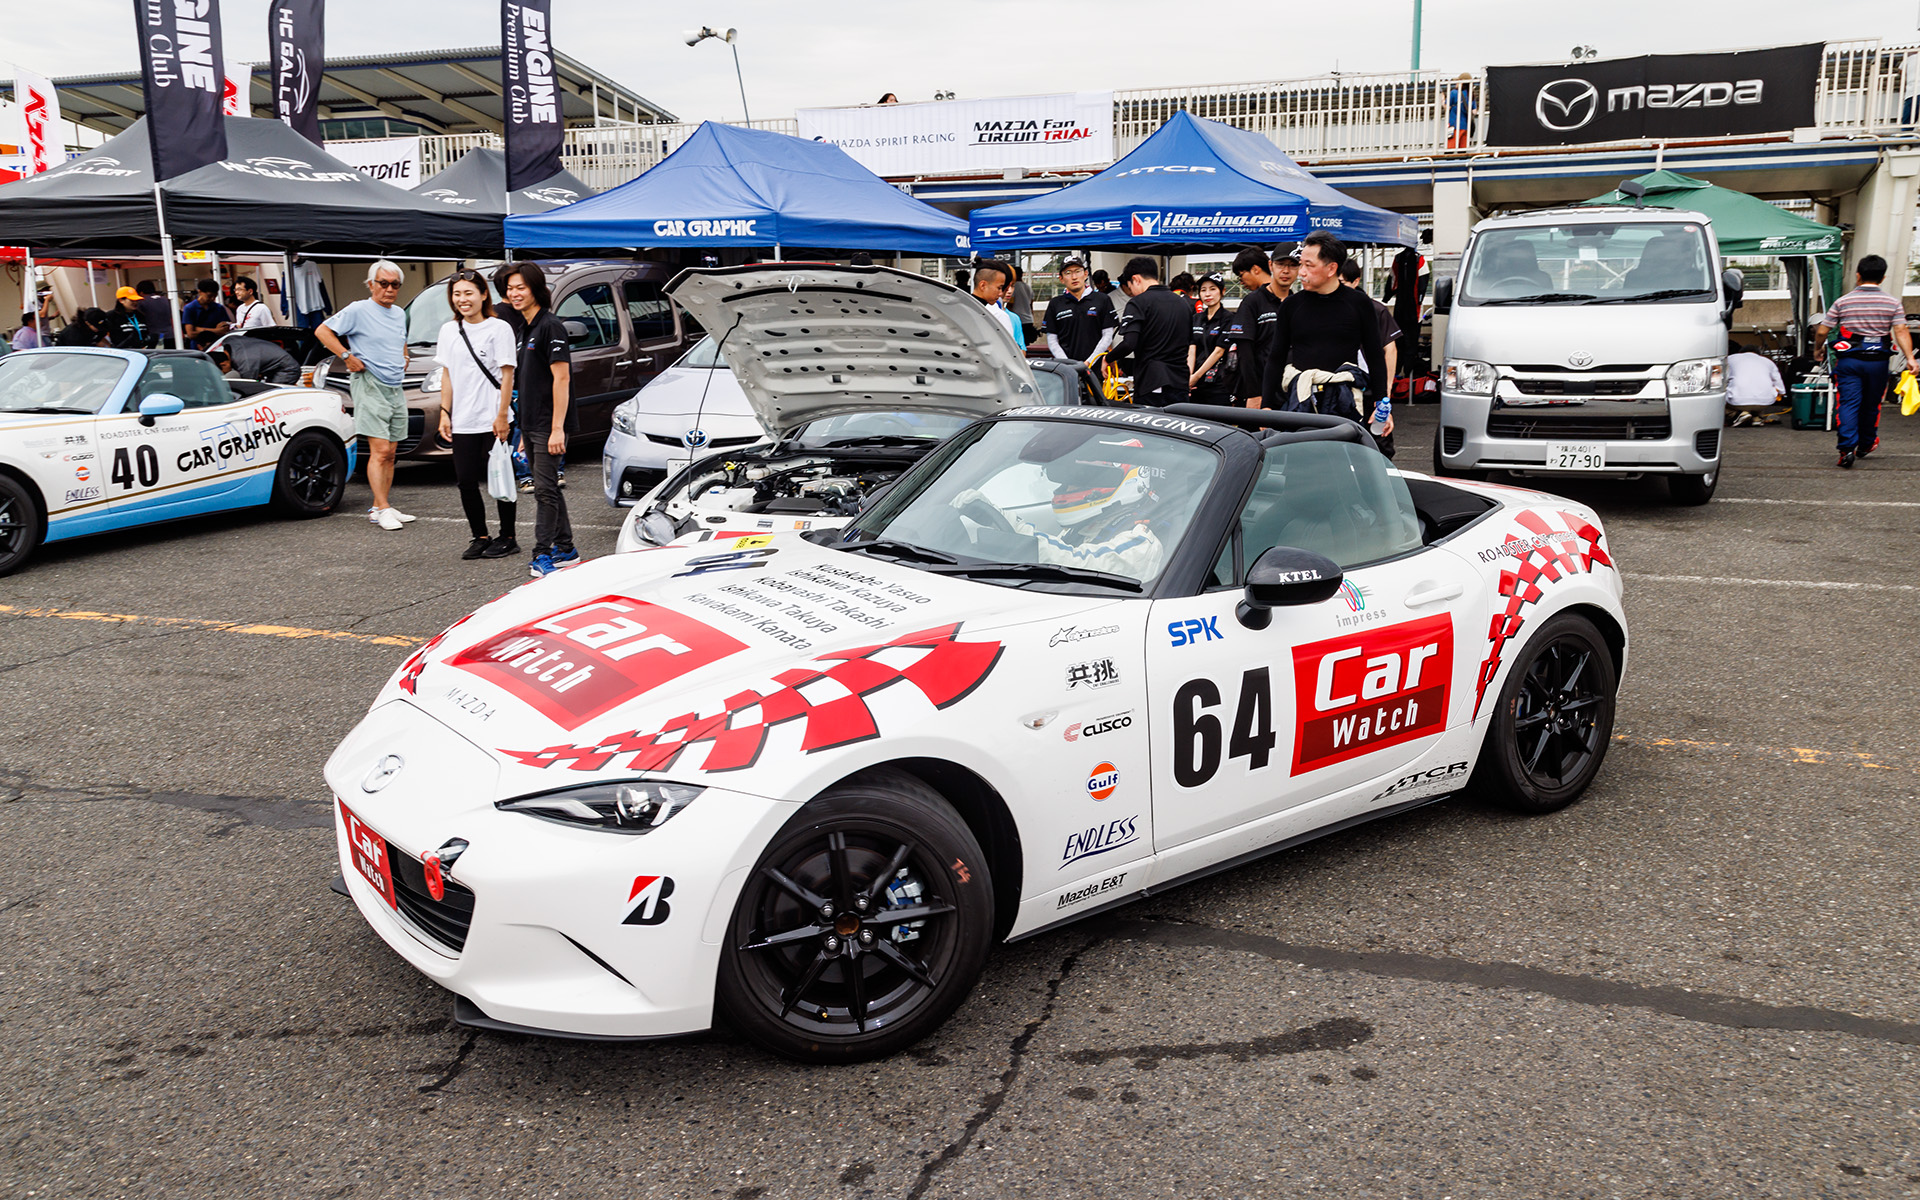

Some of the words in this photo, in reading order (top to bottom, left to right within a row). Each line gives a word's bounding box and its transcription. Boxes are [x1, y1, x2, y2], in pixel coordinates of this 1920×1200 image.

[278, 8, 293, 38] HC
[506, 2, 523, 82] Premium
[150, 33, 178, 88] Club
[522, 6, 557, 124] ENGINE
[511, 84, 528, 124] Club
[830, 138, 871, 149] MAZDA
[875, 136, 907, 147] SPIRIT
[912, 132, 956, 144] RACING
[977, 131, 1042, 143] CIRCUIT
[1043, 127, 1093, 141] TRIAL
[1043, 119, 1076, 130] Fan
[217, 160, 259, 175] HC
[254, 167, 361, 182] GALLERY
[653, 219, 688, 237] CAR
[689, 219, 756, 238] GRAPHIC
[977, 226, 1019, 237] TC
[1028, 221, 1122, 235] CORSE
[1162, 211, 1298, 228] iRacing.com
[1310, 216, 1321, 227] TC
[1322, 217, 1343, 228] CORSE
[101, 429, 142, 440] ROADSTER
[144, 427, 160, 436] CNF
[162, 425, 190, 433] concept
[254, 406, 276, 426] 40
[998, 406, 1057, 416] MAZDA
[1060, 406, 1125, 420] SPIRIT
[1122, 414, 1210, 436] RACING
[177, 446, 216, 472] CAR
[218, 421, 292, 459] GRAPHIC
[1560, 454, 1602, 468] 27-90
[111, 444, 160, 491] 40
[65, 486, 100, 501] ENDLESS
[1477, 538, 1533, 563] ROADSTER
[1531, 533, 1549, 547] CNF
[785, 568, 851, 591] Ishikawa
[849, 586, 908, 614] Kazuya
[811, 563, 884, 588] Kusakabe
[882, 582, 932, 605] Yasuo
[1278, 569, 1322, 583] KTEL
[718, 583, 779, 609] Ishikawa
[779, 603, 838, 634] Takuya
[752, 576, 835, 604] Kobayashi
[831, 598, 895, 630] Takashi
[1336, 608, 1387, 628] impress
[532, 602, 693, 662] Car
[683, 592, 765, 624] Kawakami
[753, 617, 813, 651] Kanata
[1167, 615, 1224, 648] SPK
[490, 636, 595, 694] Watch
[1067, 658, 1119, 688] 共挑
[1313, 641, 1439, 713] Car
[444, 685, 497, 722] MAZDA
[1172, 665, 1277, 788] 64
[1332, 699, 1419, 749] Watch
[1087, 773, 1119, 791] Gulf
[1404, 761, 1468, 783] TCR
[349, 814, 383, 868] Car
[1062, 815, 1139, 861] ENDLESS
[358, 852, 386, 893] Watch
[1057, 883, 1099, 907] Mazda
[1101, 872, 1128, 891] E&T
